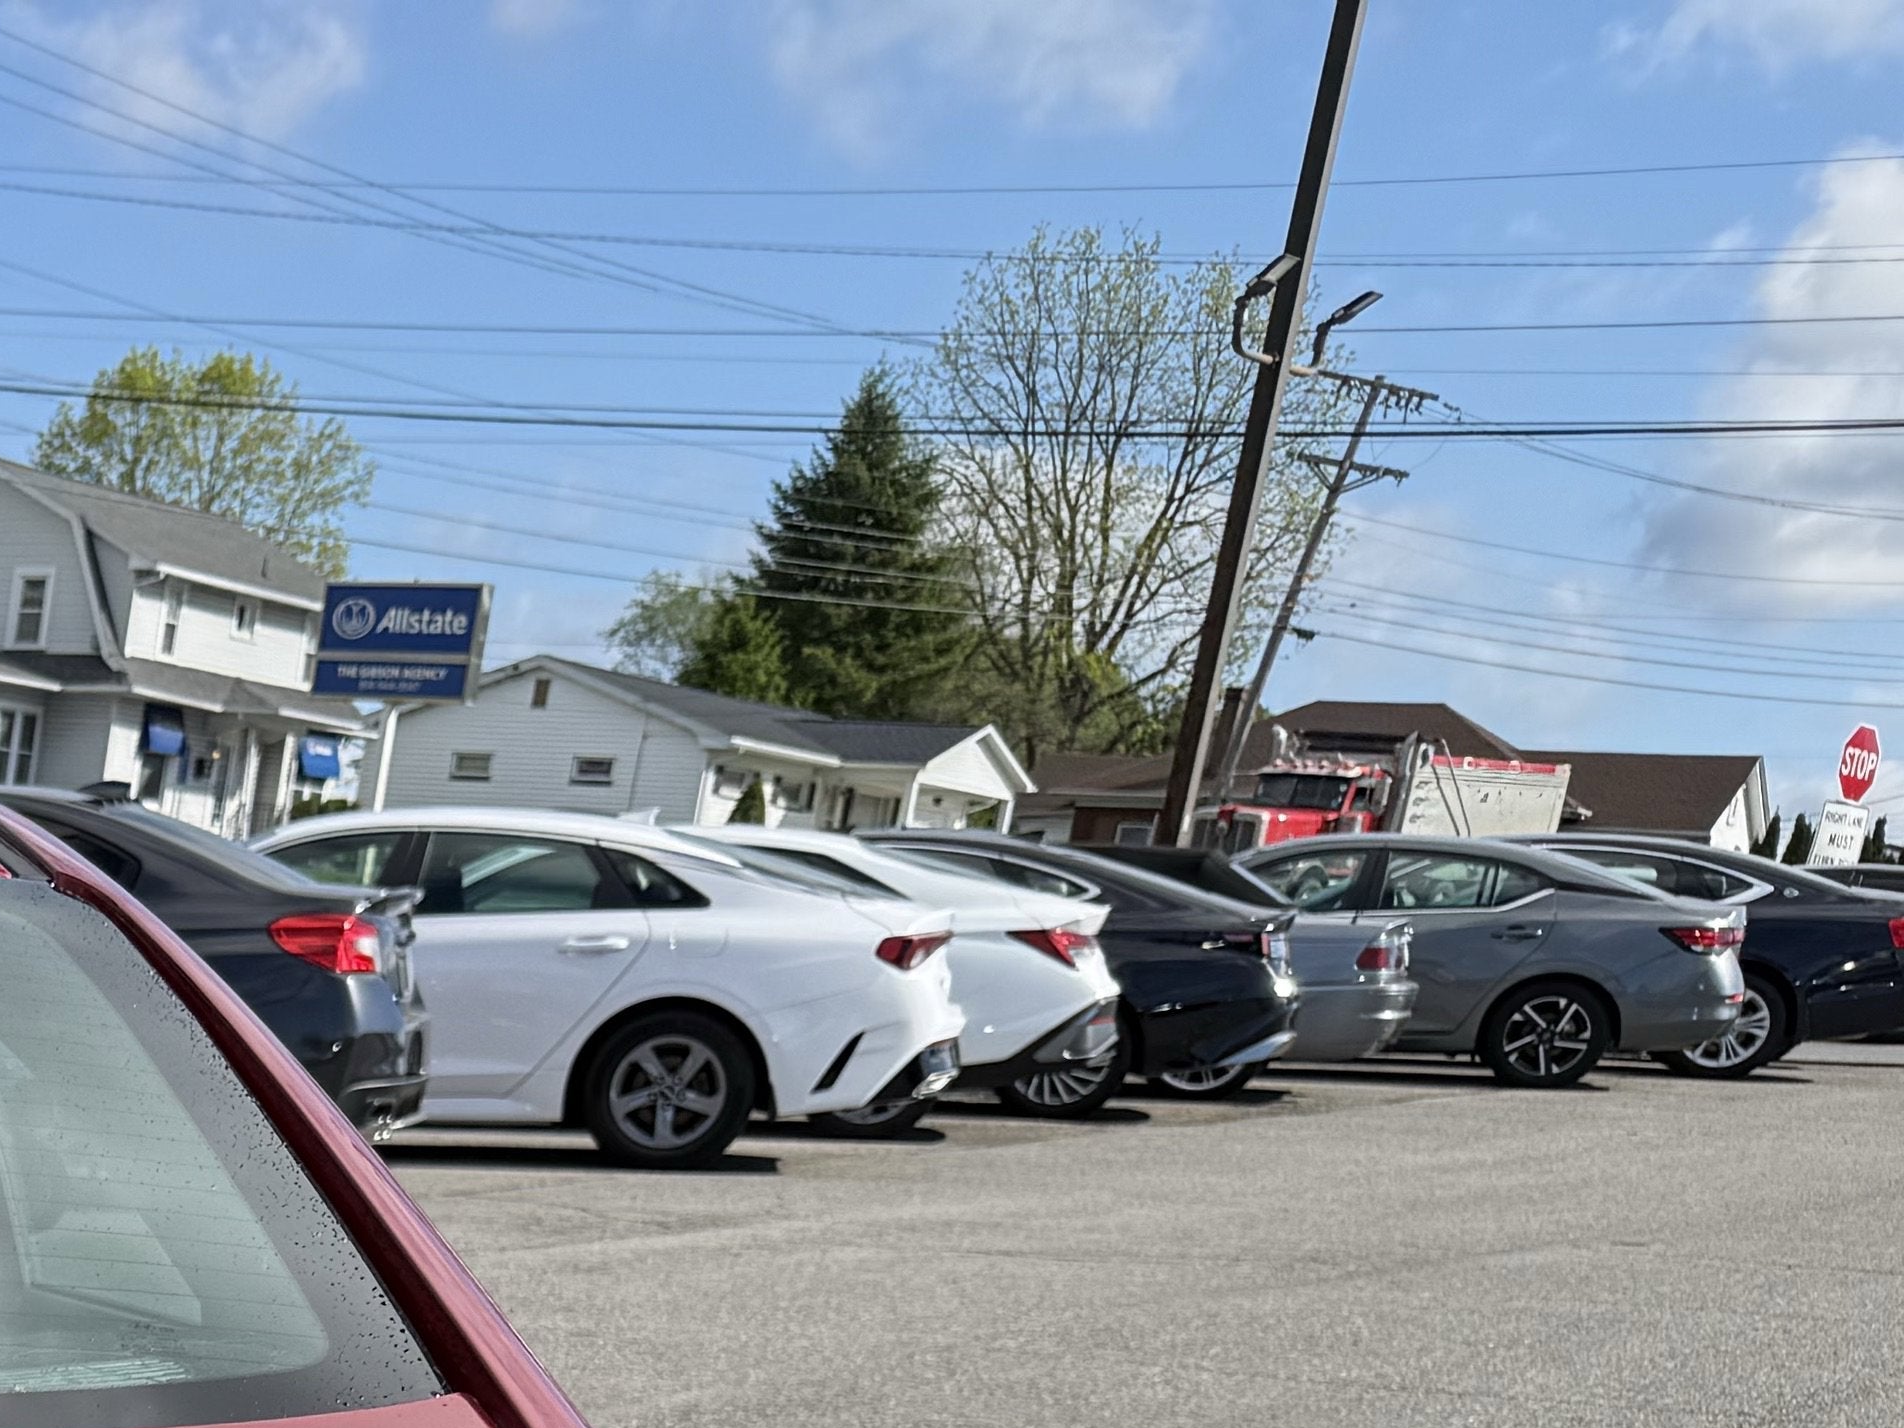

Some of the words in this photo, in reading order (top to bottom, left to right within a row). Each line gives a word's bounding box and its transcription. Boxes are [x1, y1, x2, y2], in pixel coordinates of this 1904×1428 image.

[375, 606, 468, 635] Allstate
[1841, 746, 1878, 781] STOP
[1825, 811, 1848, 826] RIGHT
[1828, 833, 1854, 850] MUST
